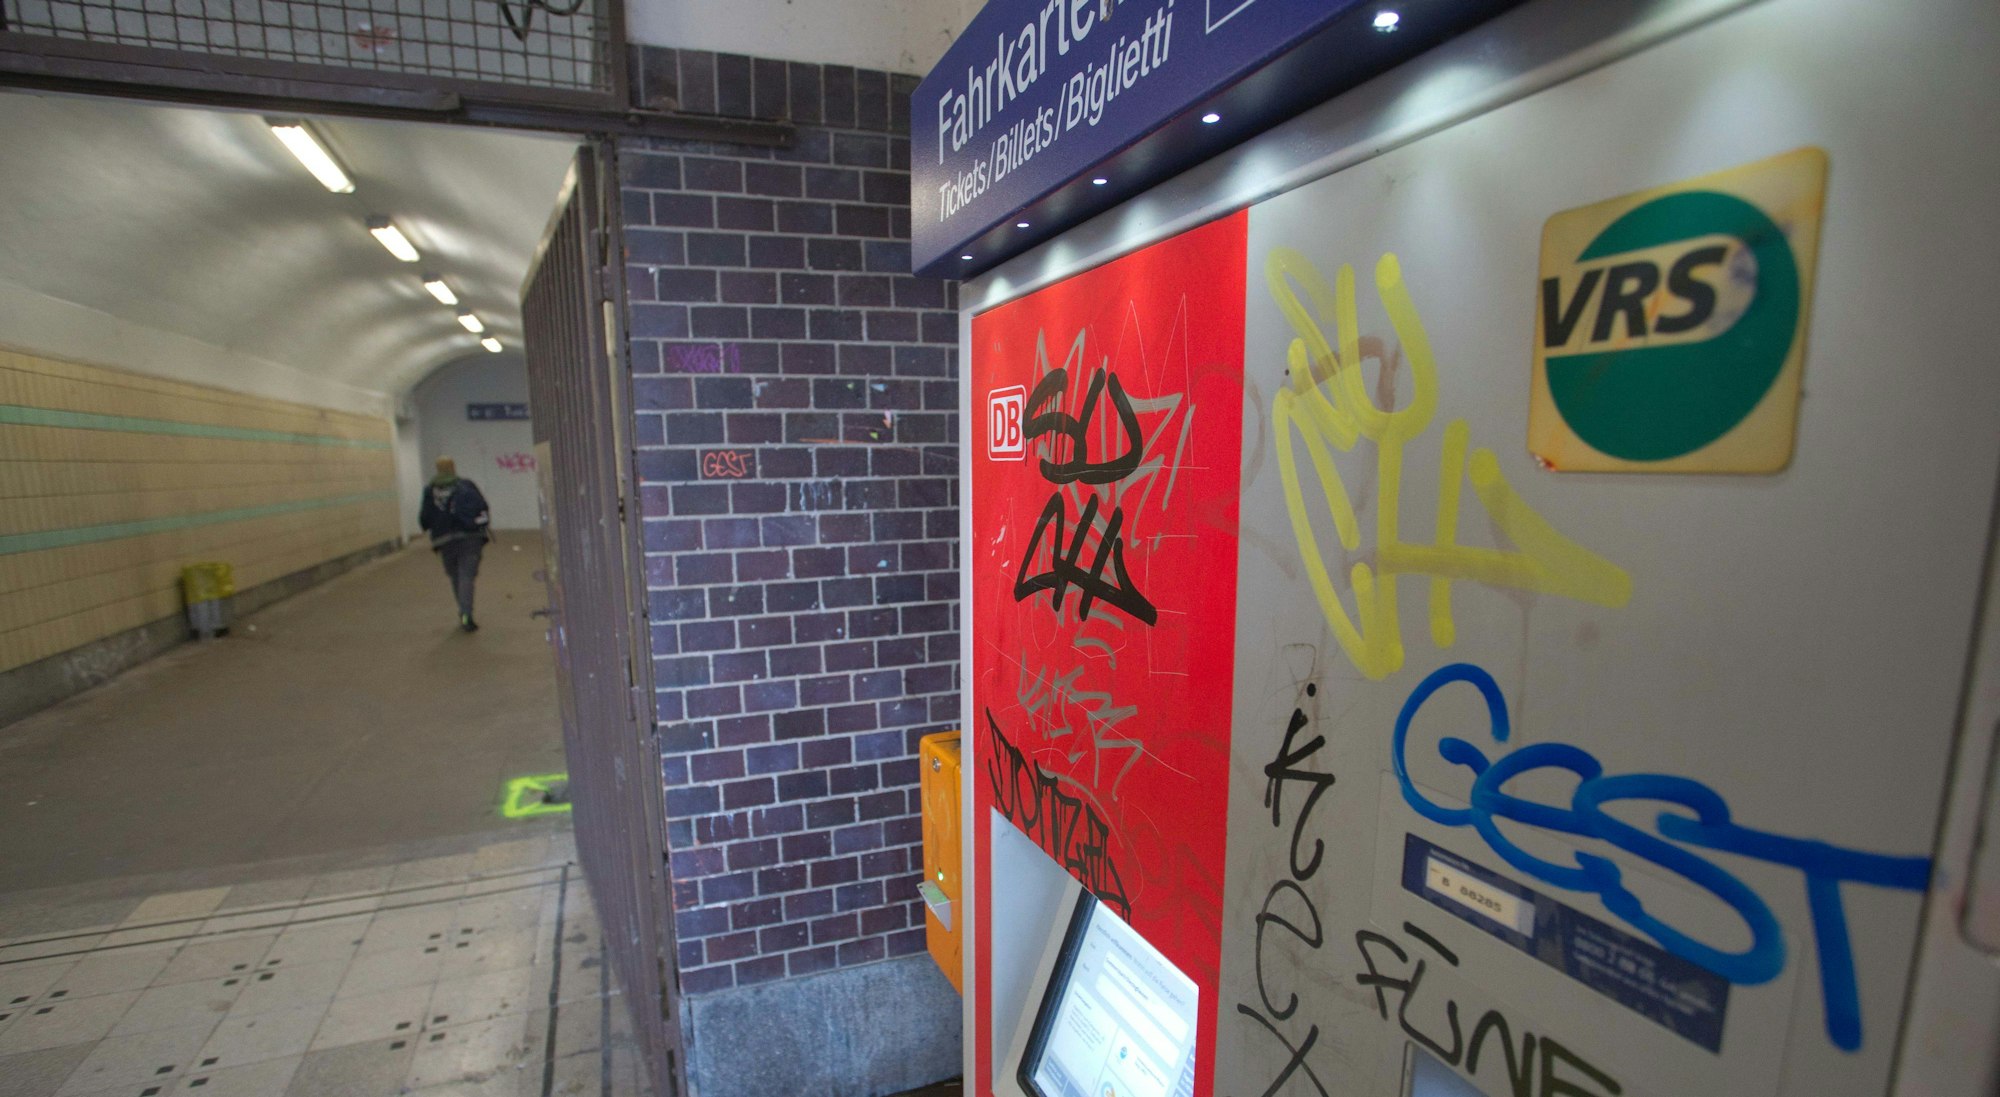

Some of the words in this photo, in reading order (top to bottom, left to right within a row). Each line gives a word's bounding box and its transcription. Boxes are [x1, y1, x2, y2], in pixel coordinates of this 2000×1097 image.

[1541, 245, 1732, 349] VRS
[993, 396, 1022, 449] DB
[703, 450, 752, 478] GEST
[1392, 663, 1931, 1054] GEST
